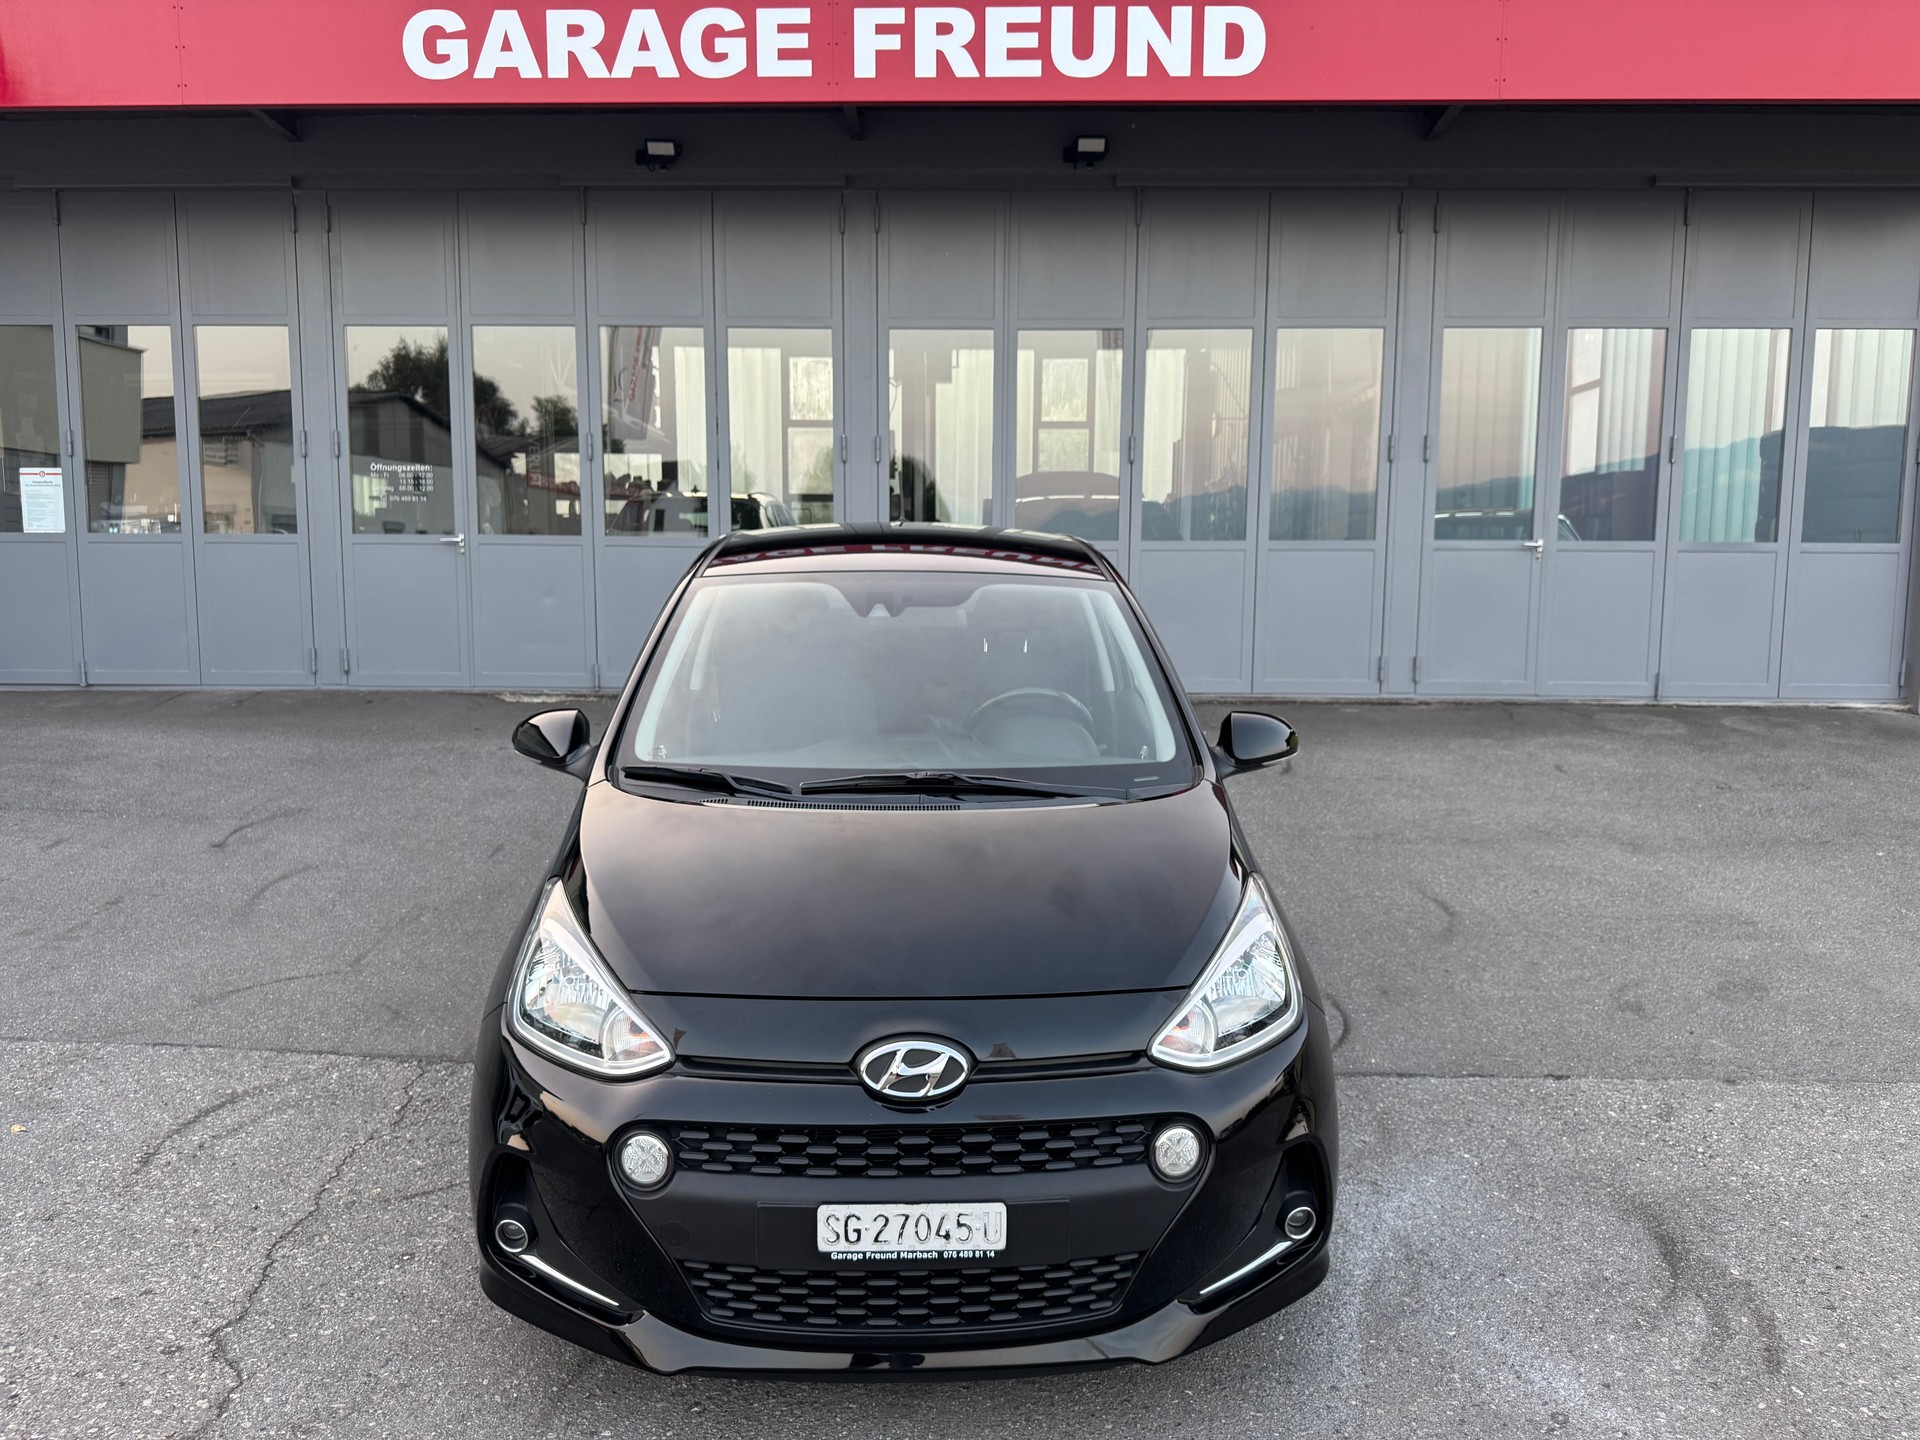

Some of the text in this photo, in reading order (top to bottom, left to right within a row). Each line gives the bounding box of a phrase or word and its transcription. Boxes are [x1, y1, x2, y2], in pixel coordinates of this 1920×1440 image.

[402, 5, 1267, 81] GARAGE FREUND
[370, 462, 433, 473] Öffnungszeiten:
[831, 1250, 995, 1260] Garage Freund Marbach 076 489 81 14
